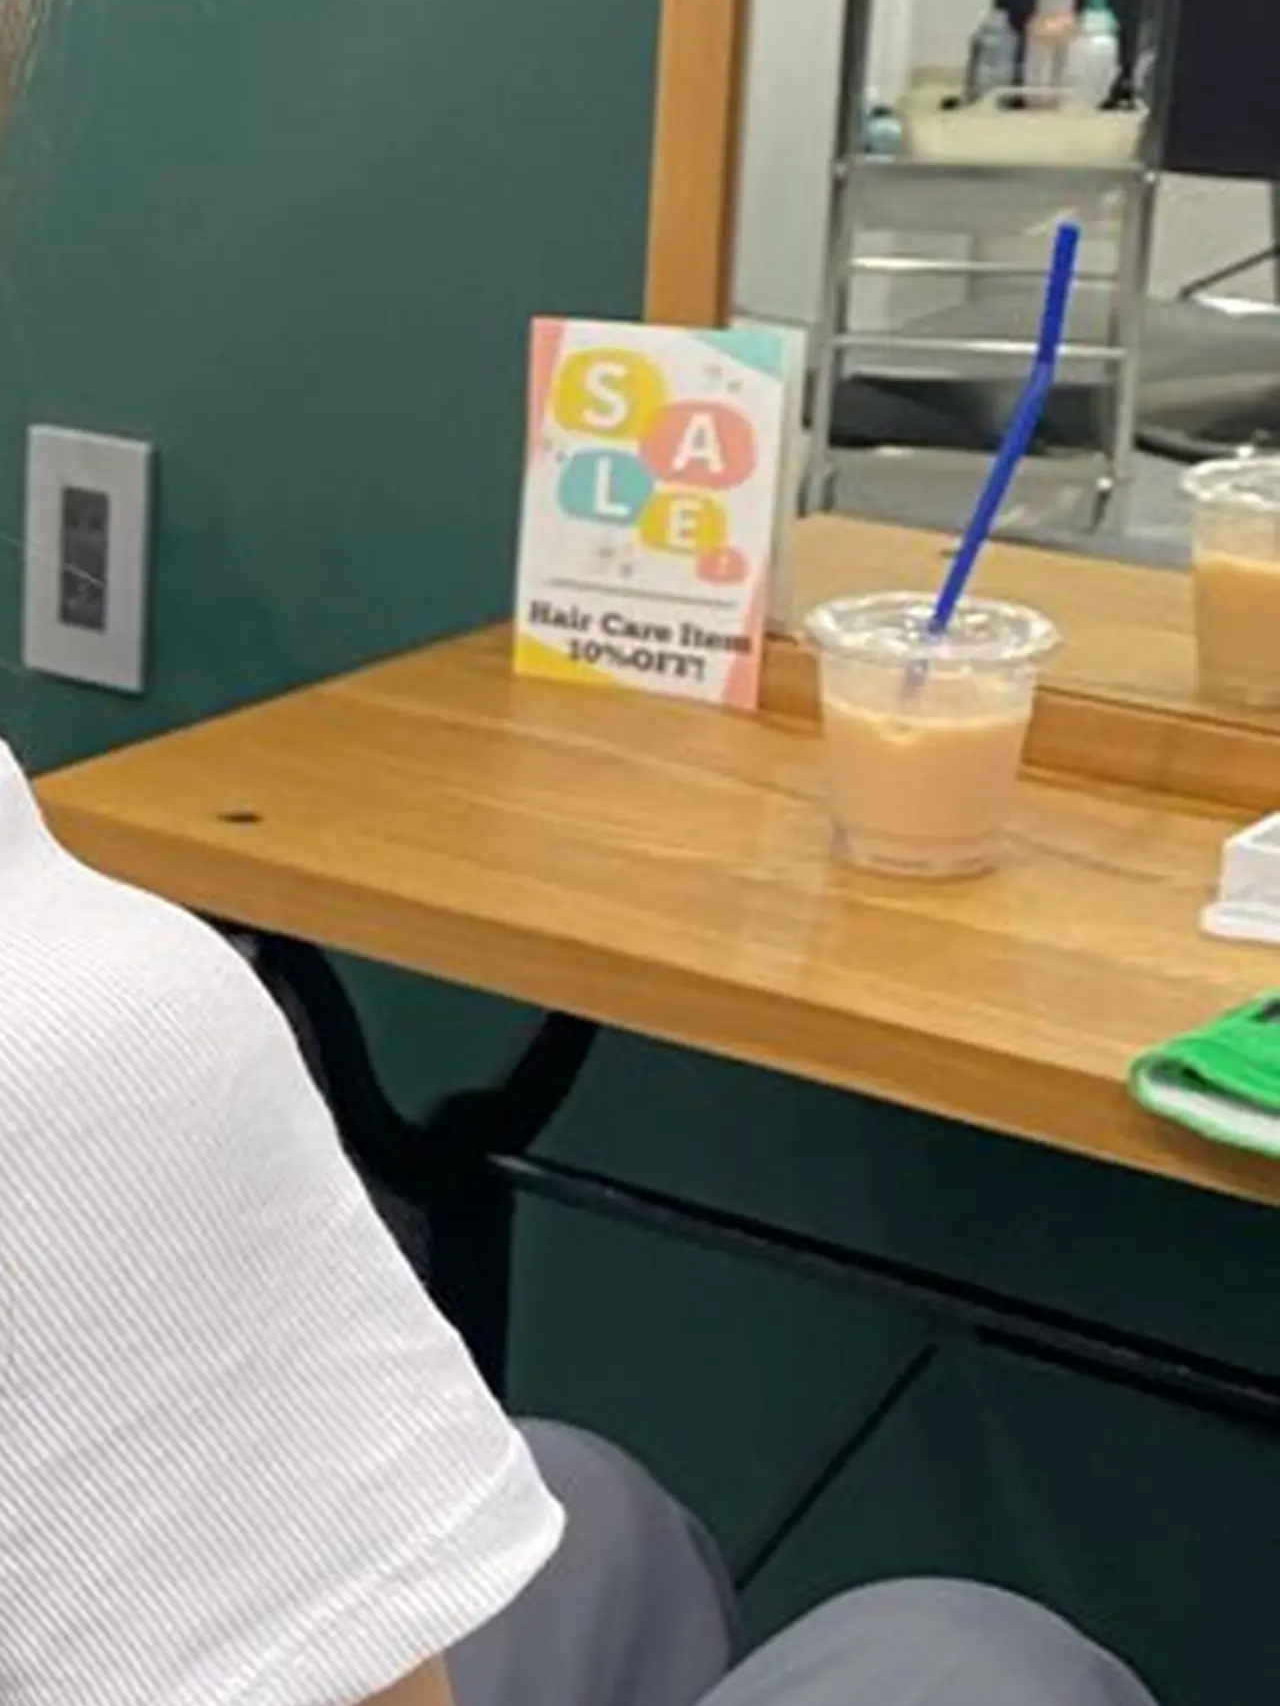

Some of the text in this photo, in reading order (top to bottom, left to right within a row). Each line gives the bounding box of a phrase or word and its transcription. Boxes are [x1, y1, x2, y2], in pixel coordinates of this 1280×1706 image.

[529, 600, 753, 654] Hair Care Item
